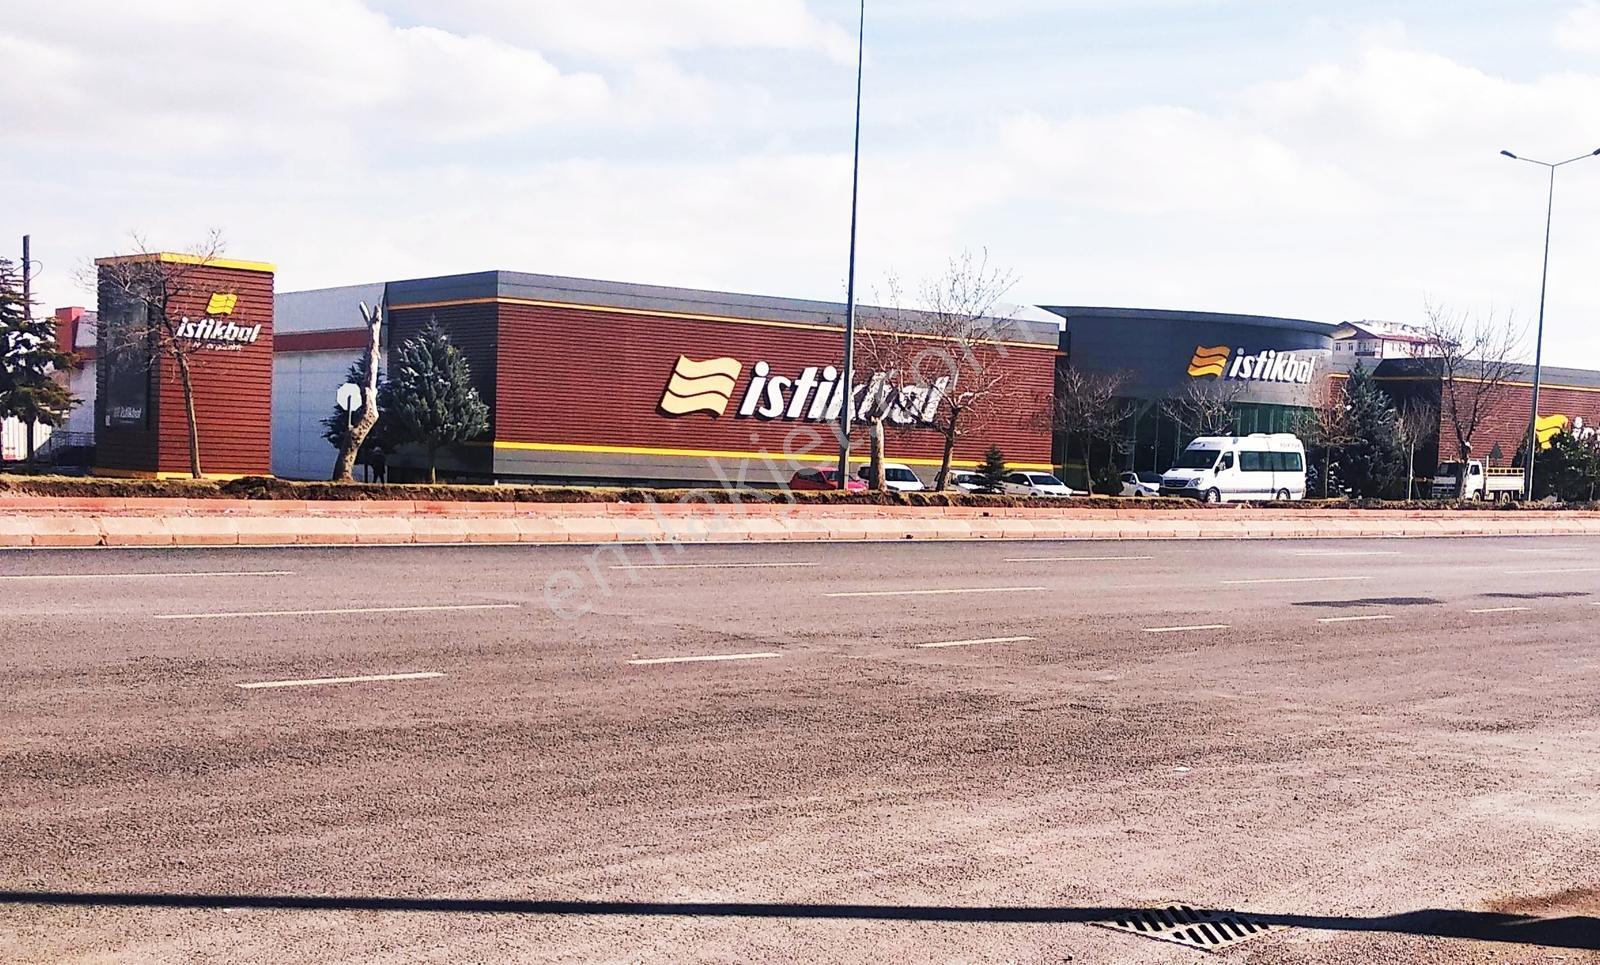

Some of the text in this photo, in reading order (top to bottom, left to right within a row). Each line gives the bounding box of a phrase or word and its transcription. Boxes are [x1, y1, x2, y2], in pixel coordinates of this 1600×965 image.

[176, 317, 262, 343] istikbal
[1229, 347, 1317, 384] istikbal
[740, 361, 950, 424] istikbal
